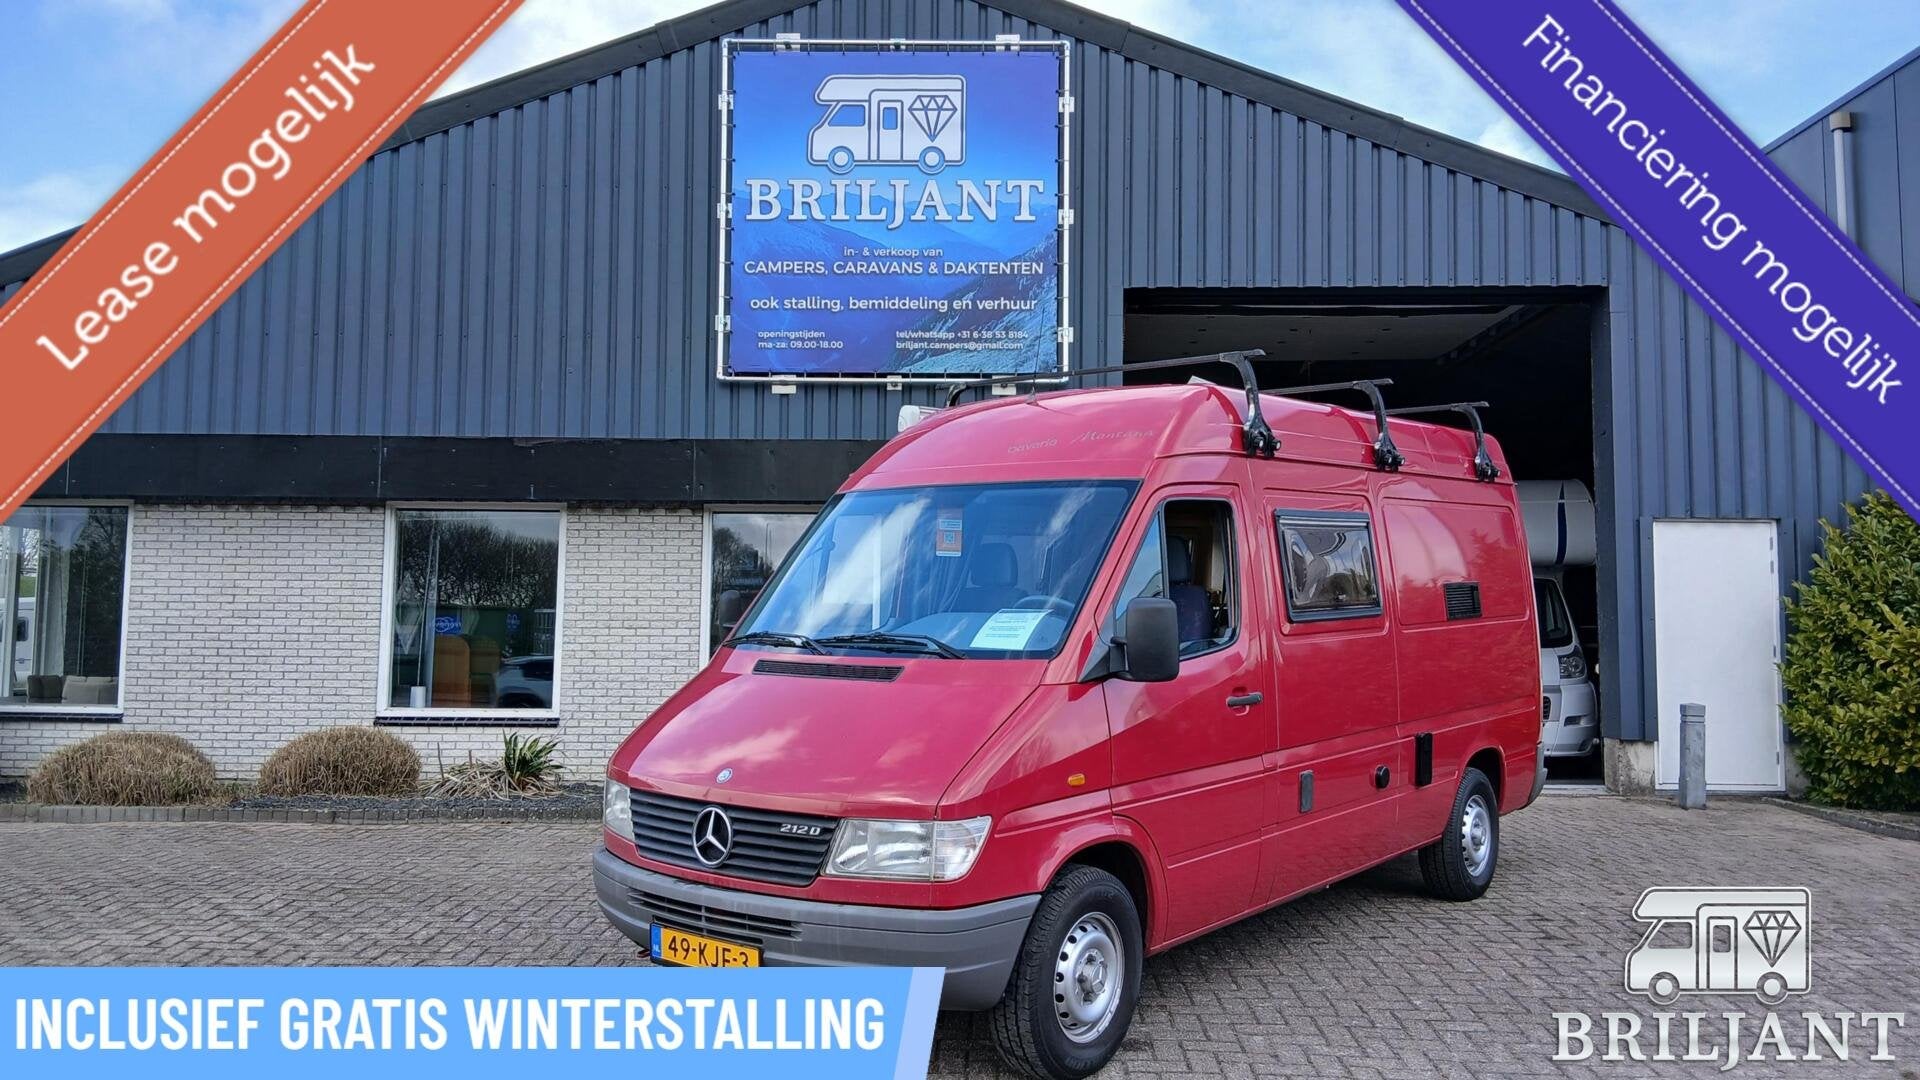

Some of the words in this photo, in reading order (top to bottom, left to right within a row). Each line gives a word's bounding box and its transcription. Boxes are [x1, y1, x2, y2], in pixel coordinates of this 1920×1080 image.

[745, 179, 1044, 230] BRILJANT
[862, 247, 870, 256] &
[873, 247, 919, 258] verkoop
[922, 248, 943, 256] van
[744, 261, 828, 275] CAMPERS,
[833, 261, 923, 274] CARAVANS
[928, 262, 938, 274] &
[944, 262, 1044, 274] DAKTENTEN
[750, 296, 779, 309] ook
[783, 296, 844, 312] stalling,
[849, 296, 948, 312] bemiddeling
[952, 299, 972, 309] en
[976, 297, 1037, 310] verhuur
[758, 330, 825, 339] openingstijden
[896, 330, 955, 339] tel/whatsapp
[790, 340, 843, 349] 09.00-18.00
